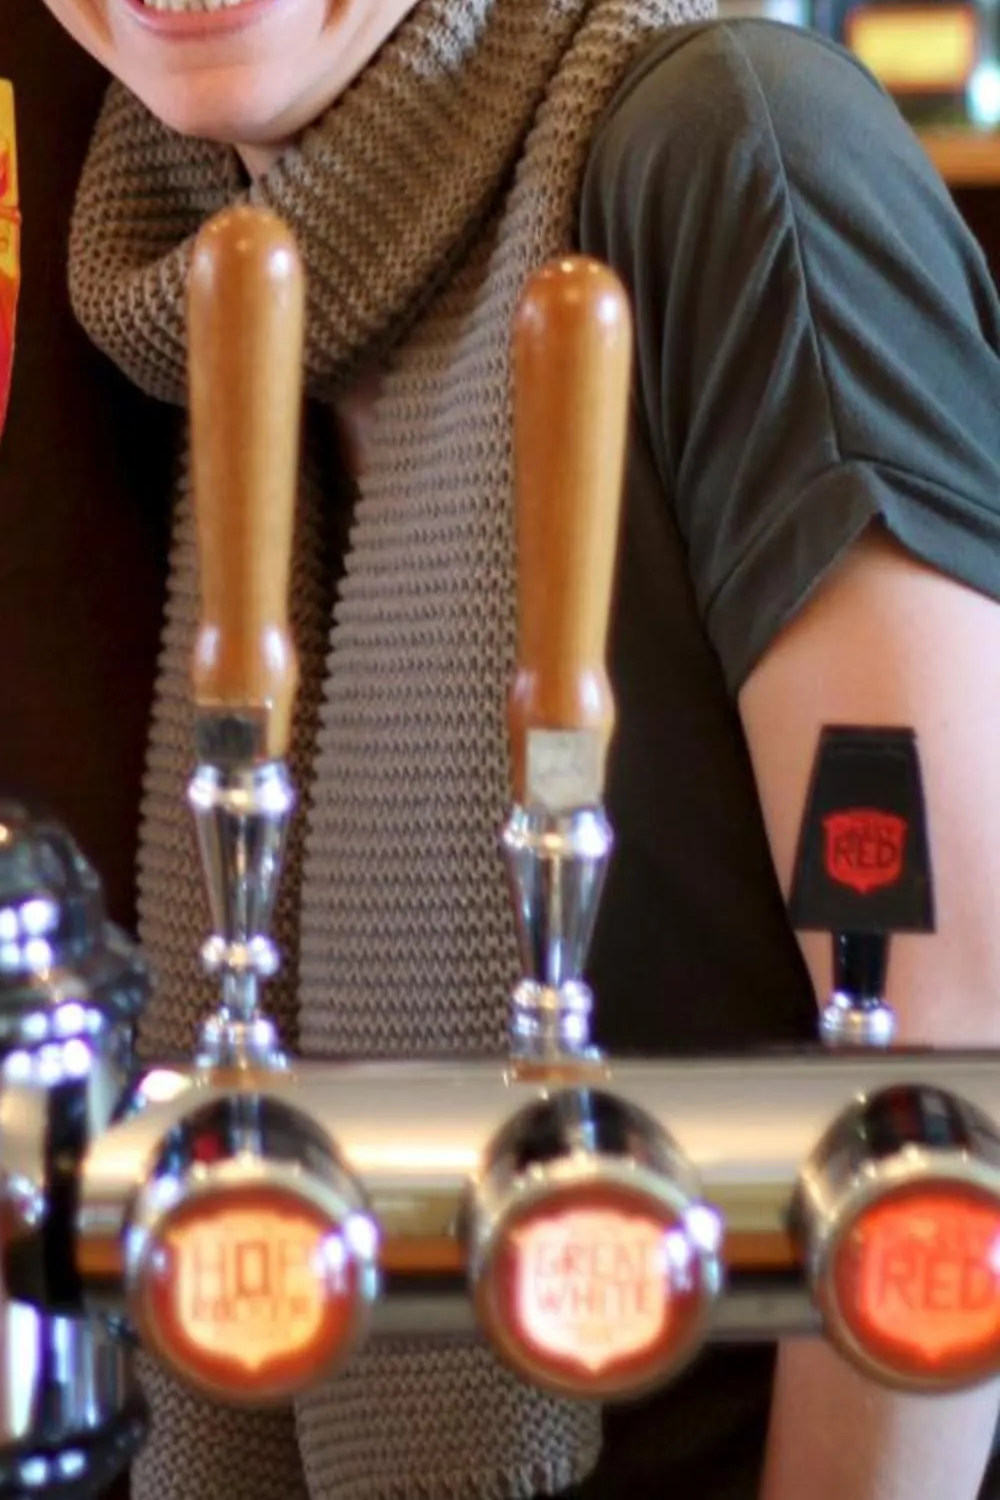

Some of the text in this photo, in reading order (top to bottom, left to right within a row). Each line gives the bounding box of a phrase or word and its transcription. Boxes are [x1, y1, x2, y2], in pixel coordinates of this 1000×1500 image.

[836, 830, 898, 871] RED
[535, 1279, 651, 1315] WHITE
[881, 1246, 996, 1312] RED
